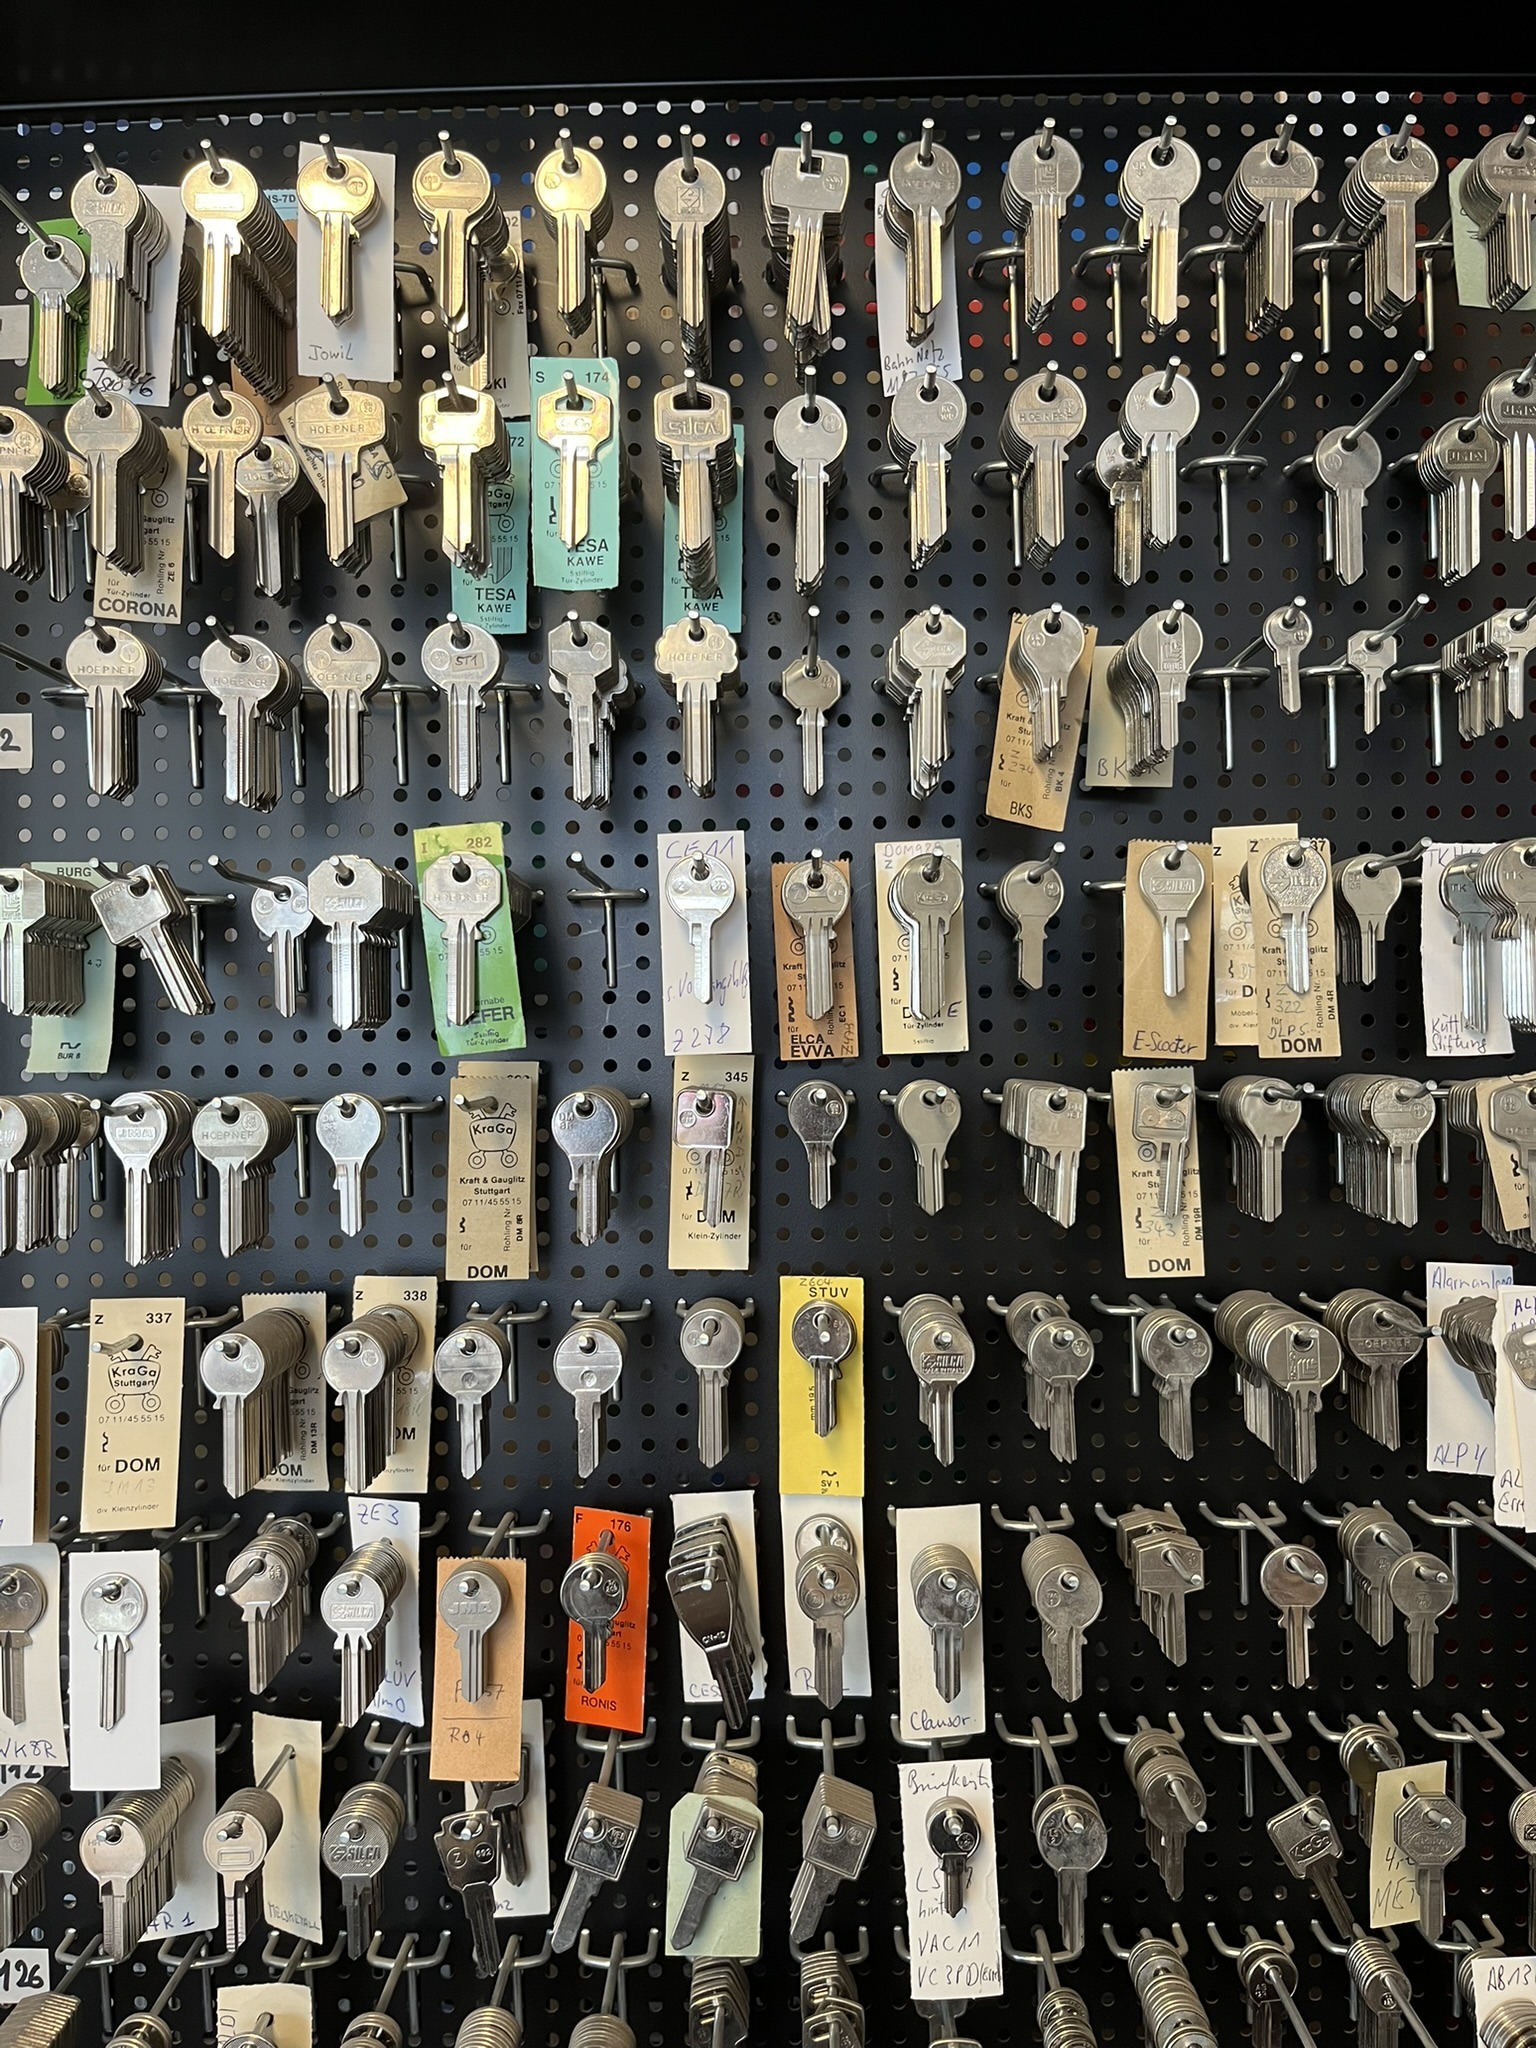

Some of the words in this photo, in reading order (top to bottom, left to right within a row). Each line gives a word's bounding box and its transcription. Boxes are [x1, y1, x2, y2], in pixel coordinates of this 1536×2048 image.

[535, 371, 545, 383] S
[585, 371, 609, 383] 174
[567, 555, 604, 567] KAWE
[107, 578, 120, 588] für
[156, 561, 166, 594] Rohling
[463, 578, 474, 587] für
[106, 588, 151, 599] Tür-Zylinder
[475, 587, 516, 601] TESA
[98, 597, 178, 617] CORONA
[478, 603, 512, 613] KAWE
[684, 602, 719, 613] KAWE
[668, 652, 723, 663] HOEPNER
[77, 665, 136, 675] HOEPNER
[1006, 712, 1026, 724] Kraft
[1000, 778, 1012, 788] für
[1055, 778, 1064, 792] BK
[1009, 800, 1034, 819] BKS
[466, 837, 492, 850] 282
[1250, 840, 1259, 853] Z
[57, 866, 91, 878] BURG
[1262, 945, 1283, 955] Kraft
[783, 962, 803, 971] Kraft
[890, 997, 902, 1005] für
[1327, 989, 1335, 1003] 4R
[1316, 994, 1324, 1028] Rohling
[1327, 1005, 1335, 1020] DM
[1270, 1015, 1283, 1025] für
[787, 1024, 799, 1034] für
[791, 1034, 825, 1045] ELCA
[1281, 1038, 1322, 1053] DOM
[57, 1052, 74, 1060] BUR
[790, 1045, 835, 1058] EVVA
[681, 1072, 689, 1082] Z
[725, 1071, 748, 1083] 345
[117, 1128, 155, 1139] JMA
[472, 1123, 514, 1136] KraGa
[1131, 1169, 1153, 1178] Kraft
[459, 1175, 482, 1184] Kraft
[483, 1175, 489, 1184] &
[491, 1174, 526, 1186] Gauglitz
[474, 1186, 511, 1198] Stuttgart
[1514, 1182, 1526, 1191] für
[681, 1211, 692, 1221] für
[696, 1209, 736, 1223] DM
[503, 1217, 511, 1251] Rohling
[516, 1226, 524, 1242] DM
[1182, 1216, 1190, 1247] Rohling
[1194, 1227, 1202, 1241] DM
[460, 1242, 472, 1251] für
[1138, 1236, 1151, 1246] für
[1148, 1257, 1192, 1272] DOM
[467, 1264, 509, 1279] DOM
[355, 1291, 364, 1301] Z
[403, 1290, 428, 1301] 338
[808, 1286, 850, 1299] STUV
[1514, 1298, 1536, 1316] AL
[94, 1314, 104, 1325] Z
[145, 1312, 173, 1324] 337
[111, 1365, 157, 1379] KraGa
[113, 1378, 155, 1389] Stuttgart
[311, 1441, 318, 1454] DM
[97, 1463, 111, 1473] für
[115, 1457, 161, 1474] DOM
[821, 1479, 832, 1488] SV
[111, 1501, 160, 1514] Kleinzylinder
[575, 1512, 583, 1524] F
[610, 1518, 632, 1532] 176
[581, 1694, 617, 1712] RONIS
